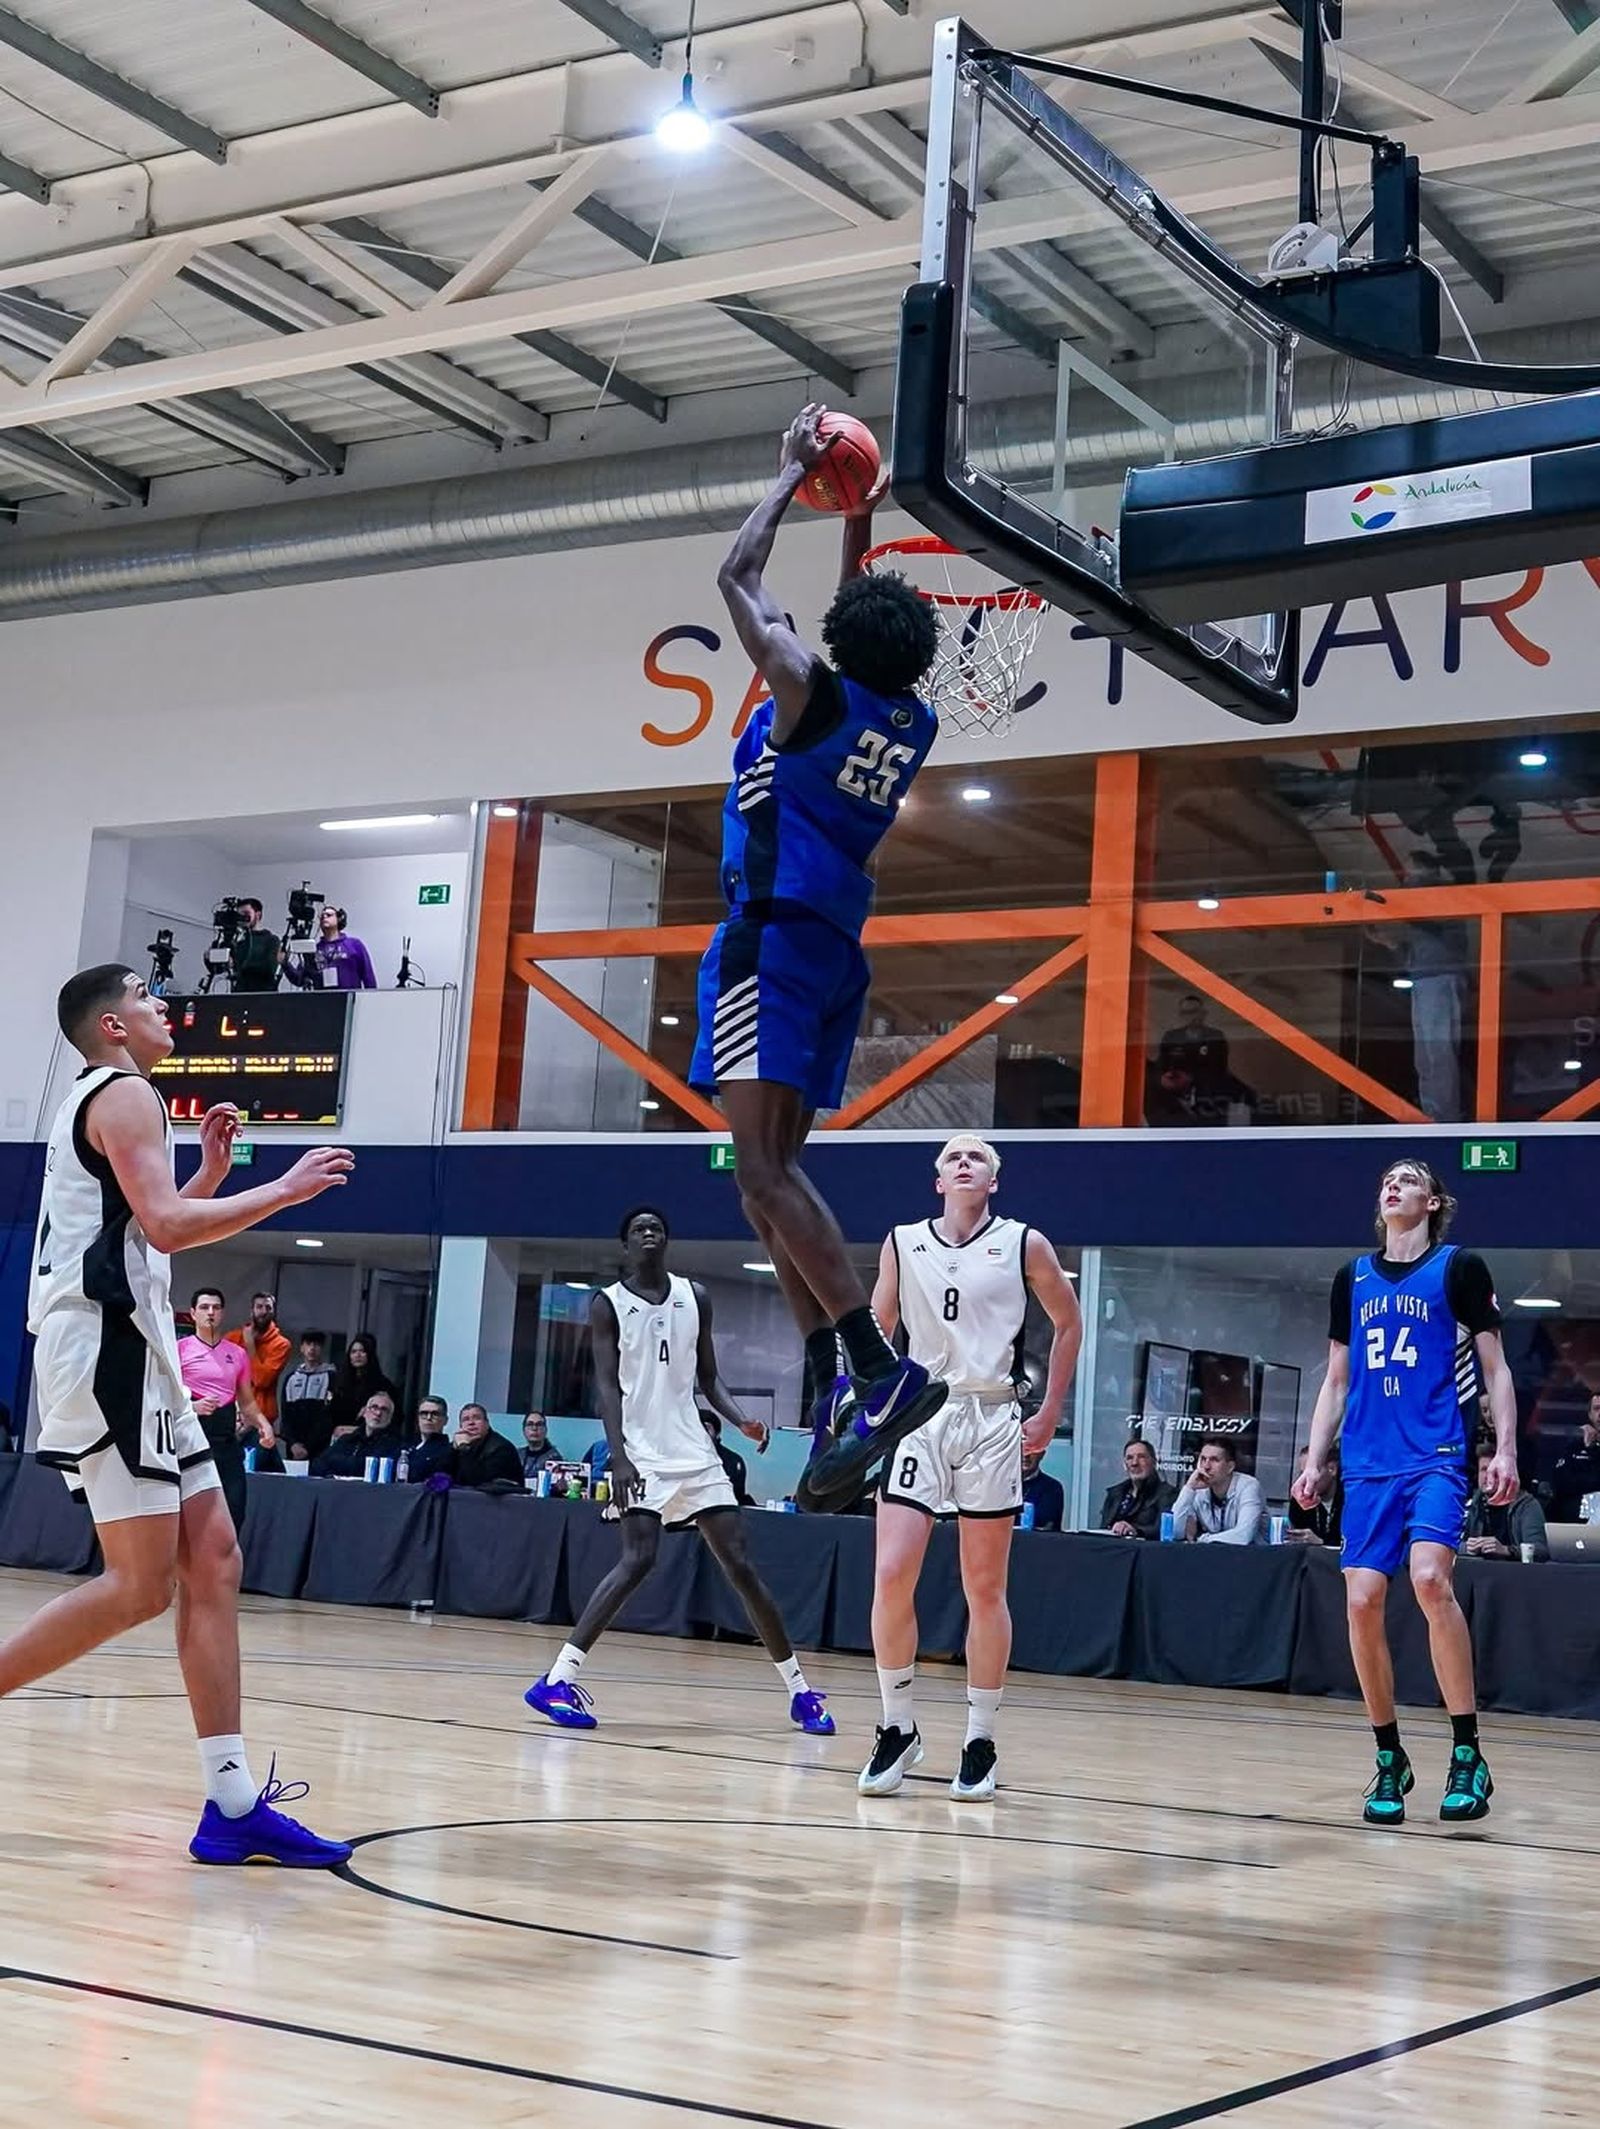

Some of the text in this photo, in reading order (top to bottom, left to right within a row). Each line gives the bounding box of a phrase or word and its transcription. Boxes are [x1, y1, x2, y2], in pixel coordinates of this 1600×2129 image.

[1404, 474, 1481, 500] Andalucía
[836, 729, 917, 806] 25
[944, 1287, 959, 1321] 8
[1396, 1294, 1428, 1323] VISTA
[659, 1339, 669, 1366] 4
[1366, 1327, 1418, 1370] 24
[156, 1408, 177, 1455] 10
[1166, 1416, 1252, 1434] EMBASSY
[899, 1456, 918, 1489] 8
